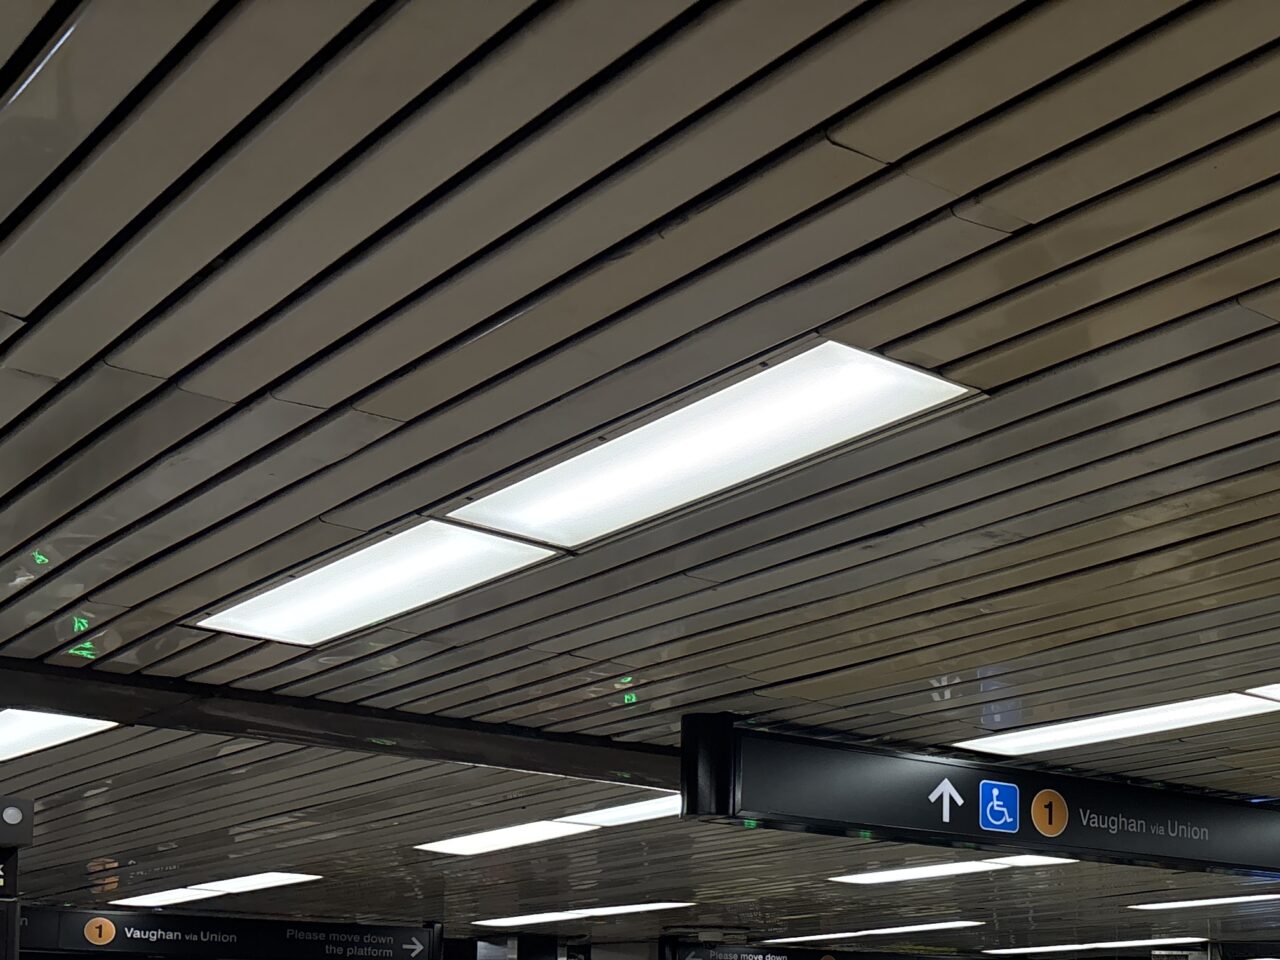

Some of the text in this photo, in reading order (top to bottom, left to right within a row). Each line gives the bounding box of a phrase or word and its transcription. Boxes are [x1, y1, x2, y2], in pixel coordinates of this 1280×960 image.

[1079, 808, 1146, 834] Vaughan
[1150, 822, 1165, 836] via
[1167, 819, 1209, 841] Union
[124, 927, 182, 942] Vaughan
[184, 932, 198, 941] via
[200, 930, 237, 943] Union
[286, 929, 394, 944] Please move down
[325, 944, 393, 958] the platform
[709, 950, 739, 960] Please
